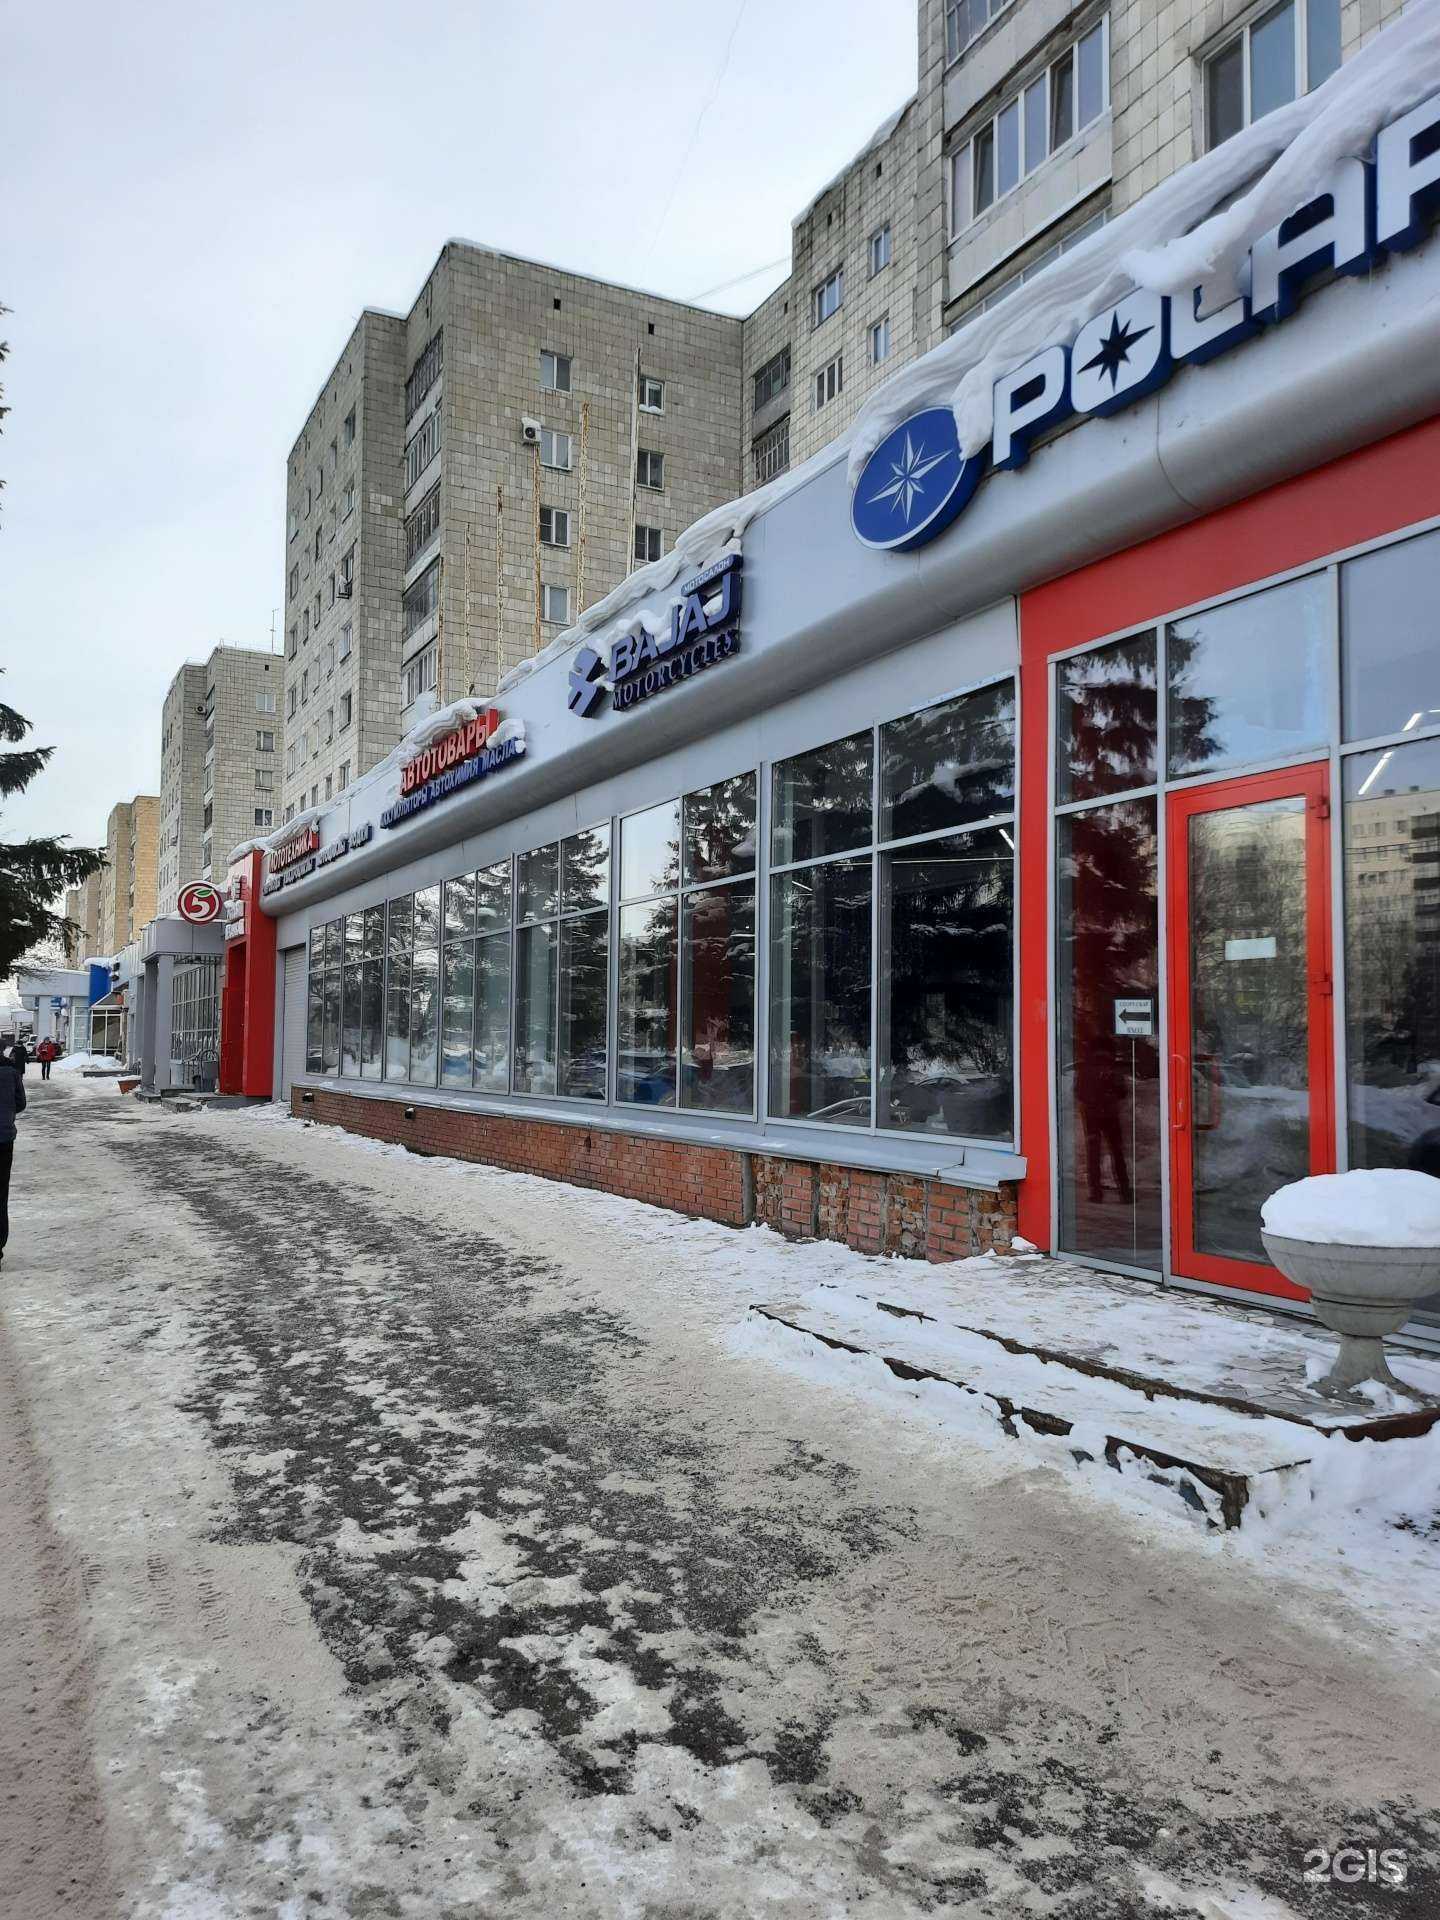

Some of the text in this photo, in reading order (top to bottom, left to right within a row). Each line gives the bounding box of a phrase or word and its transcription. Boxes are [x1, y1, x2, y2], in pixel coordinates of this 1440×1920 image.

[684, 557, 730, 592] МОТОСАЛОН
[608, 573, 731, 682] BAJAJ
[613, 631, 734, 707] MOTORCYCLES
[399, 709, 498, 794] АВТОТОВАРЫ
[430, 758, 479, 799] АВТОХИМИЯ
[481, 737, 517, 773] МАСЛА
[268, 827, 313, 872] МОТОТЕХНИКА
[191, 896, 210, 918] 5
